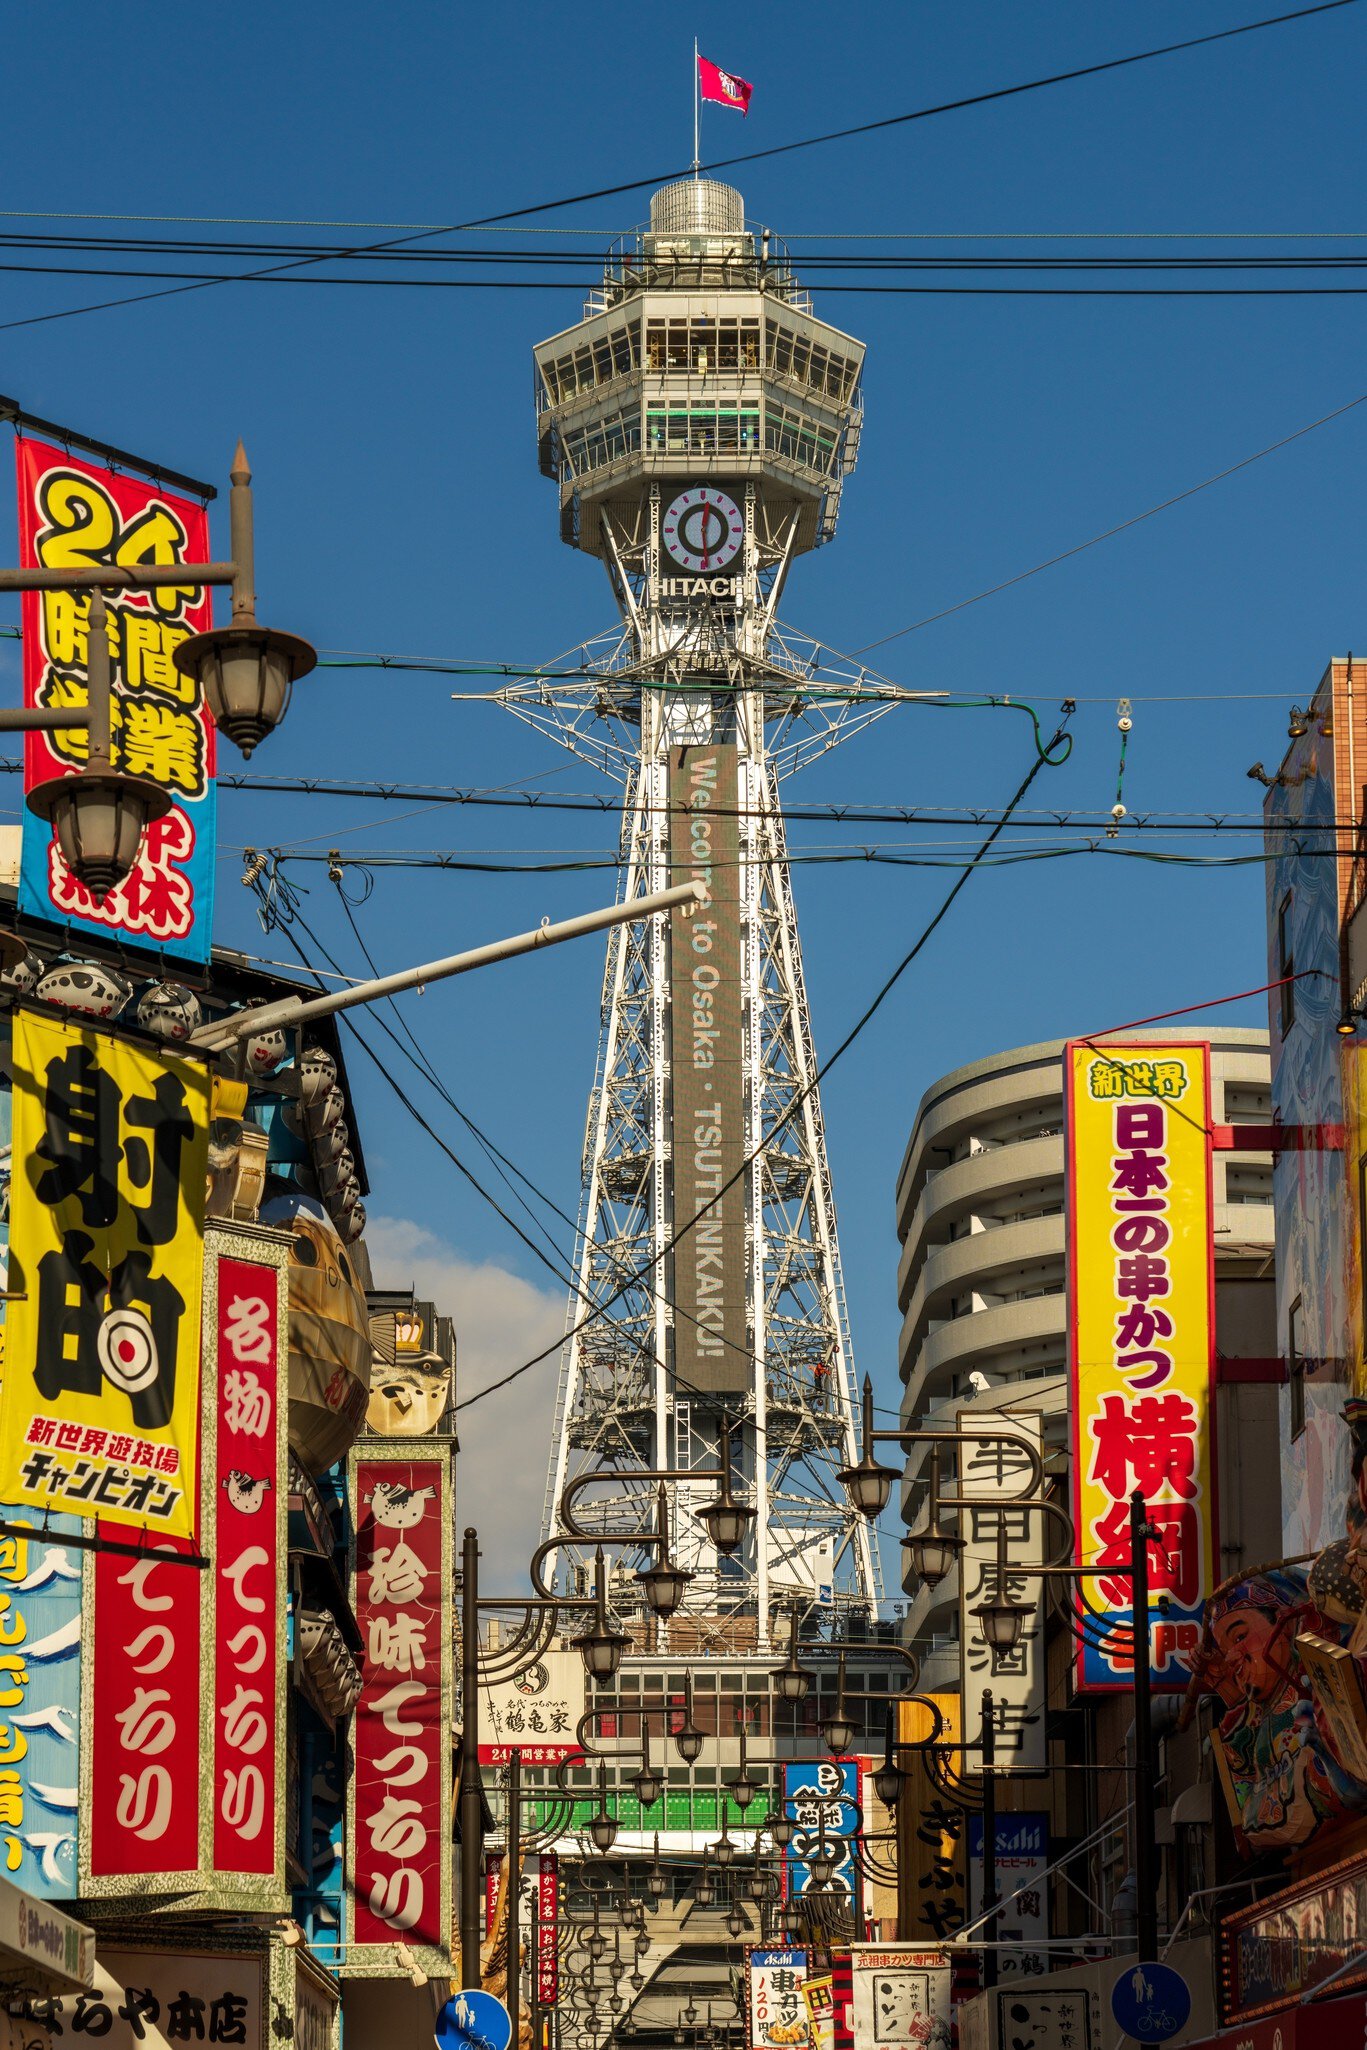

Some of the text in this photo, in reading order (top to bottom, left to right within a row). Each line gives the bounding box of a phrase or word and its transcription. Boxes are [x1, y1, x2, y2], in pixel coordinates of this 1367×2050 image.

[651, 577, 756, 597] HITACHI
[690, 757, 725, 1358] Welcome to Osaka TSUTENKAKU!
[1091, 1059, 1187, 1099] 新世界
[33, 1044, 194, 1430] 射的
[1111, 1103, 1172, 1390] 日本一の串かつ
[26, 1415, 182, 1475] 新世界遊技場
[21, 1453, 183, 1518] チャンピオン
[1092, 1394, 1198, 1608] 横綱
[221, 1295, 272, 1841] 名物 てっちり
[116, 1544, 177, 1841] てっちり
[505, 1708, 572, 1734] 鶴亀家
[367, 1541, 428, 1931] 珍味てっちり
[491, 1748, 568, 1761] 24間営業中
[764, 1953, 793, 1966] Asahi
[770, 1968, 799, 2027] 串カツ
